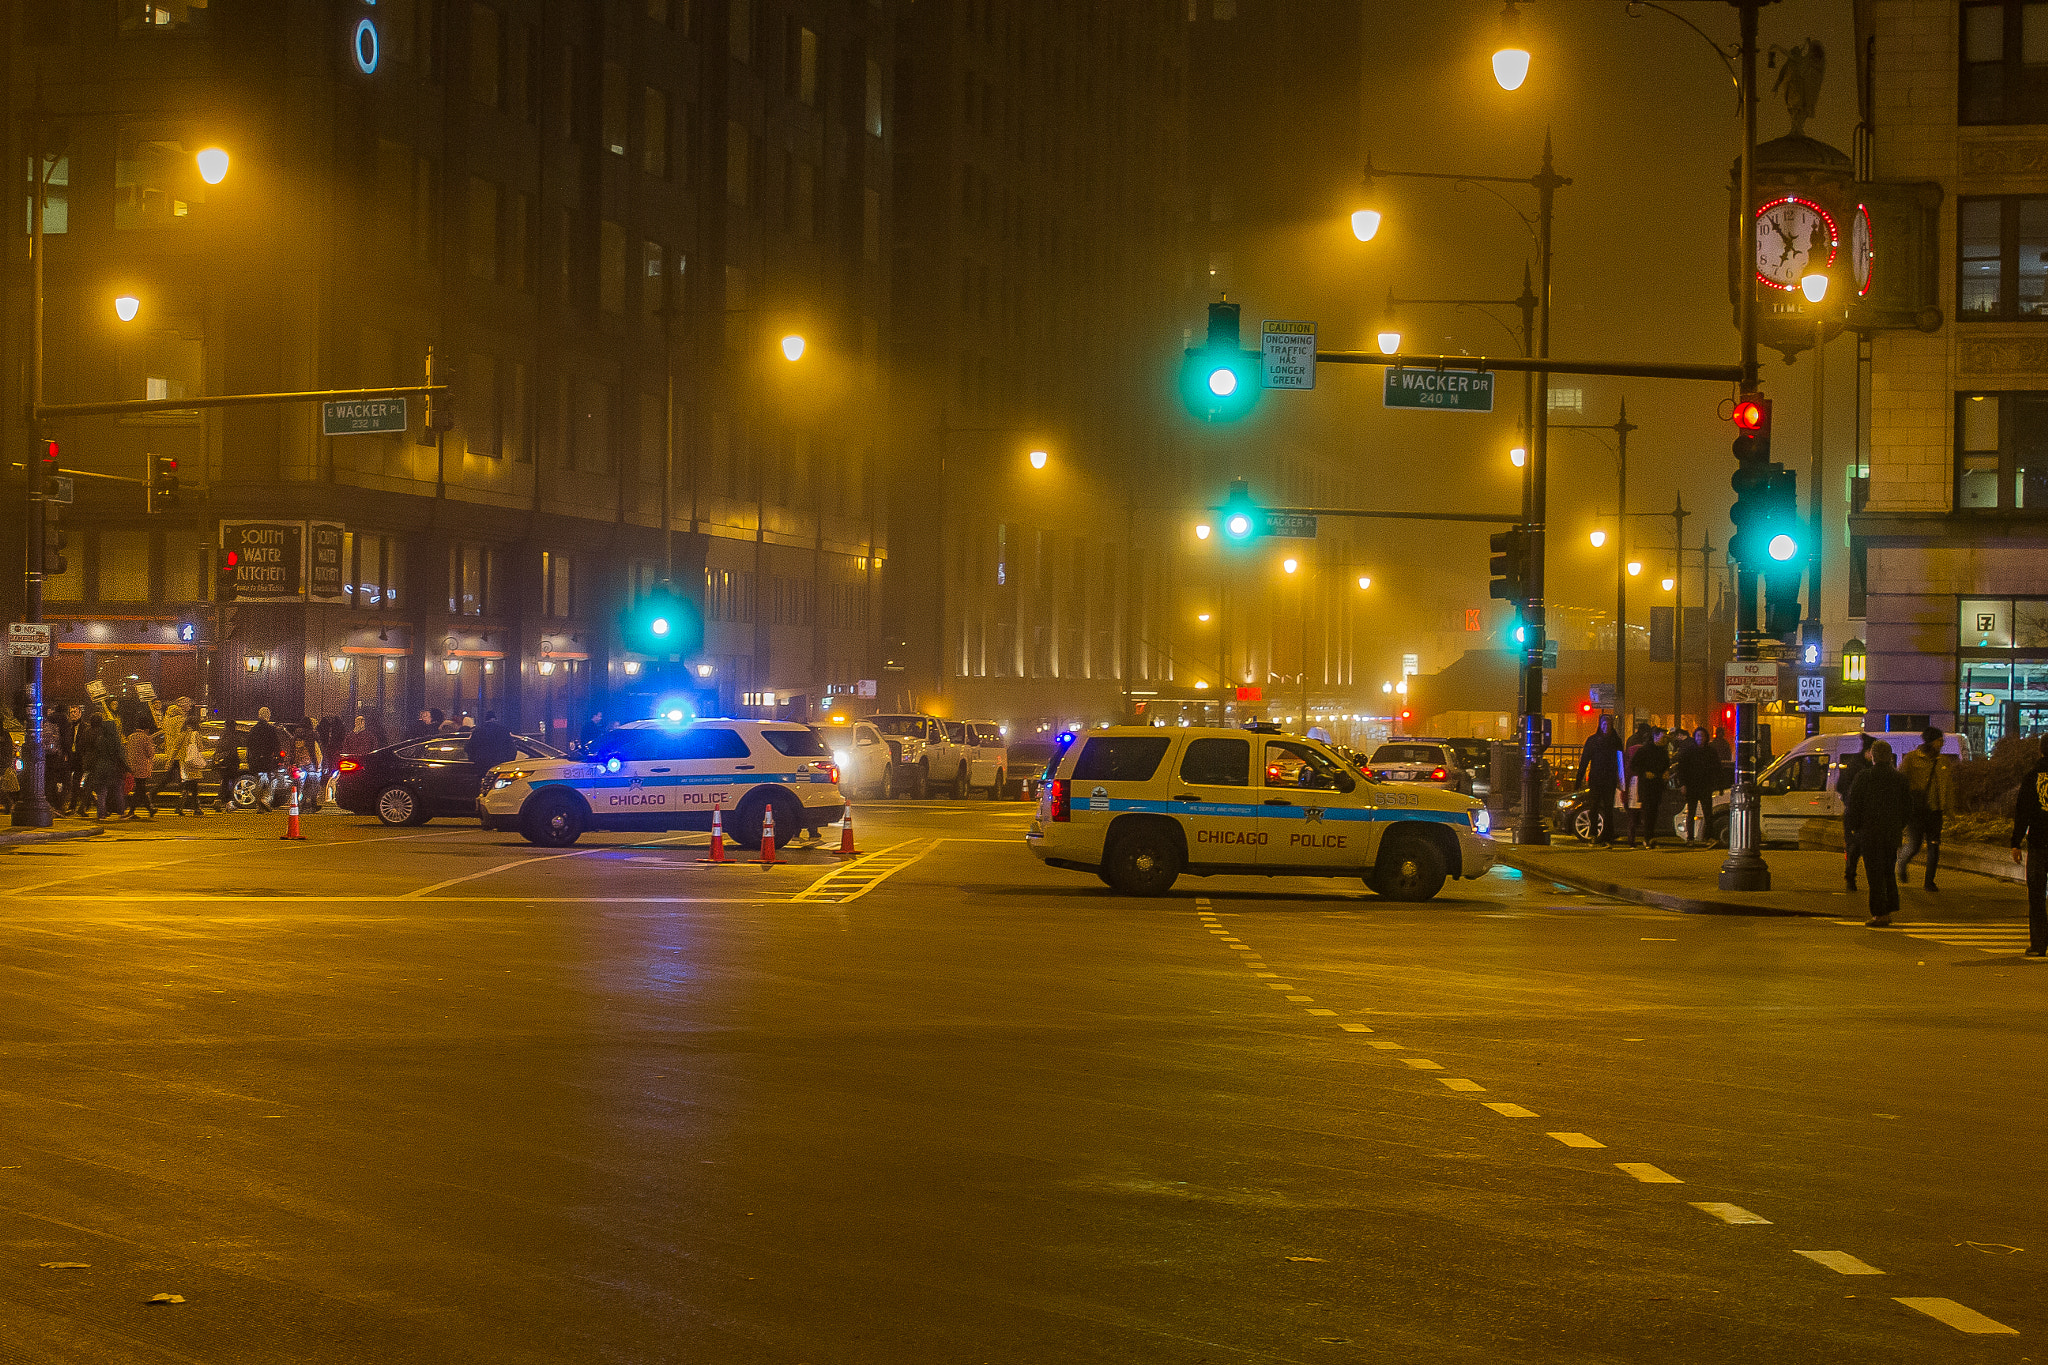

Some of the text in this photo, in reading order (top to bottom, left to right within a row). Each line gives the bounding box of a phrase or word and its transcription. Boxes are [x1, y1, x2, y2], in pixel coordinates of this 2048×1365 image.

[1773, 303, 1804, 313] TIME
[1268, 323, 1310, 333] CAUTION
[1265, 335, 1312, 345] ONCOMING
[1270, 345, 1307, 355] TRAFFIC
[1279, 356, 1297, 364] HAS
[1270, 365, 1305, 375] LONGER
[1272, 376, 1302, 385] GREEN
[1390, 374, 1489, 392] E WACKER DR
[1420, 392, 1459, 404] 240 N
[327, 403, 402, 418] E WACKER PL
[352, 419, 379, 428] 232 N
[241, 529, 284, 544] SOUTH
[243, 547, 281, 562] WATER
[236, 566, 286, 581] KITCHEN
[1465, 609, 1481, 631] K
[1744, 665, 1759, 674] NO
[1801, 679, 1821, 688] ONE
[1801, 689, 1821, 698] WAY
[609, 792, 729, 806] CHICAGO POLICE
[1375, 793, 1418, 806] 6583
[1197, 830, 1347, 848] CHICAGO POLICE
